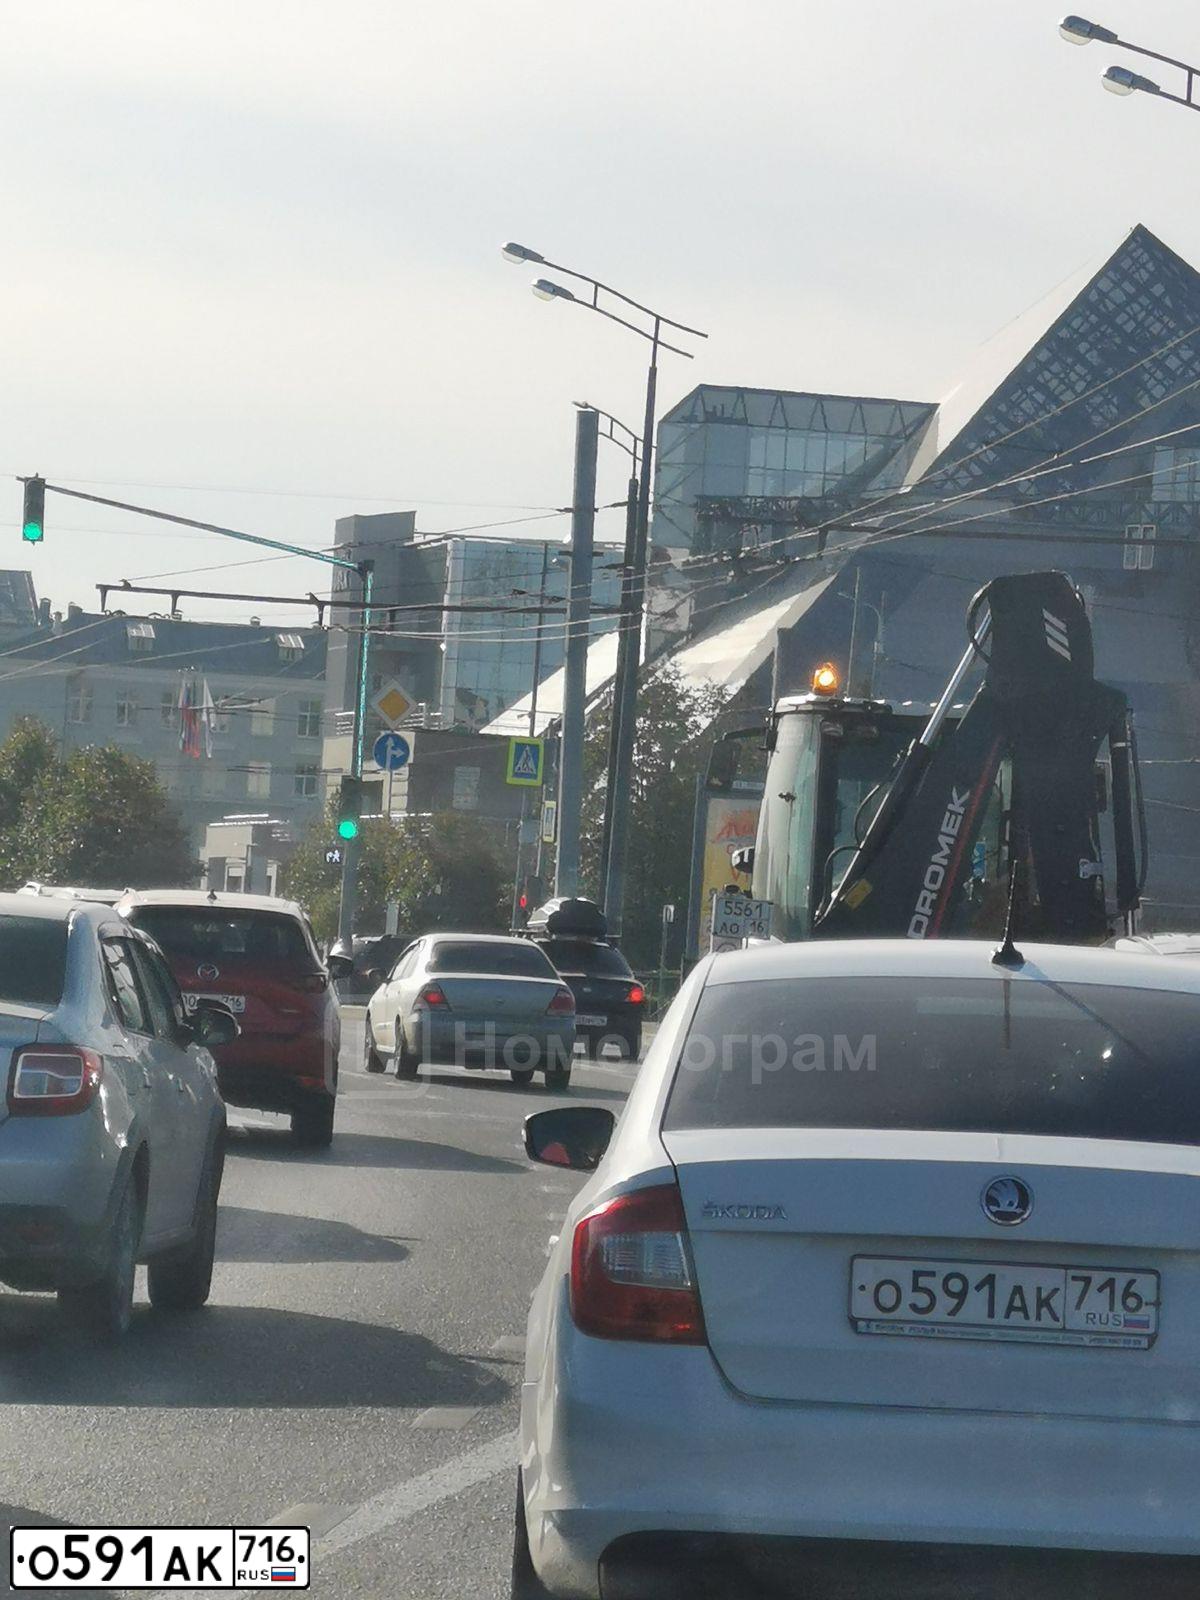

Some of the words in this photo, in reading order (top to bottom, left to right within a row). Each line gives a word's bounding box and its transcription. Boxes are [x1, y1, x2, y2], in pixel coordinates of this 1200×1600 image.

[907, 786, 970, 939] DROMEK
[723, 901, 763, 917] 5561
[751, 921, 764, 933] 16
[1071, 1275, 1143, 1313] 716
[1086, 1311, 1122, 1327] RUS
